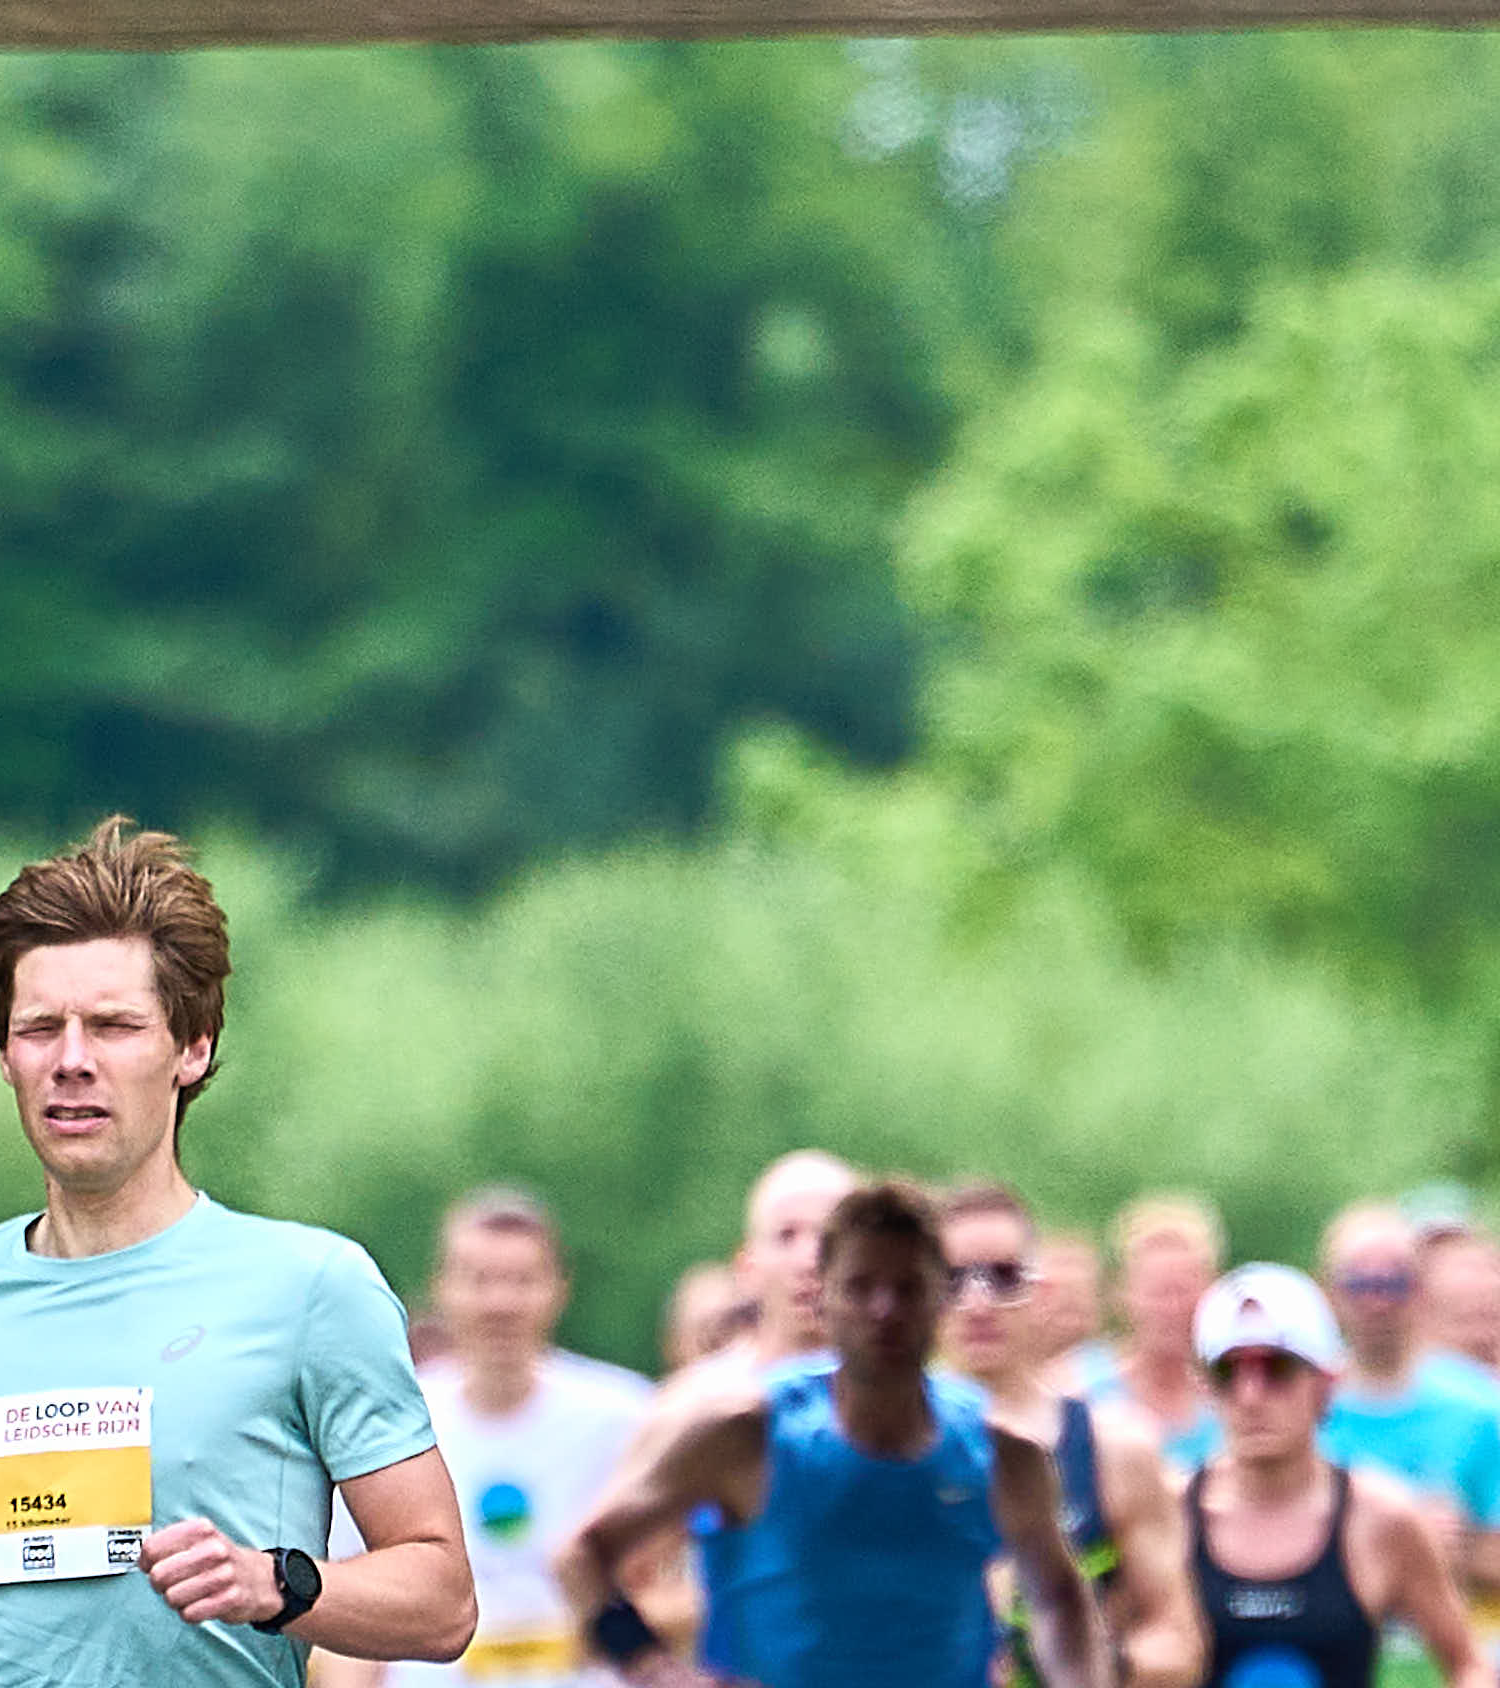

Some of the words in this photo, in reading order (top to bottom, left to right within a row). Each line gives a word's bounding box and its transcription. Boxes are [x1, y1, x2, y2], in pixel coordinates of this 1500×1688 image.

[6, 1407, 31, 1424] DE
[36, 1402, 90, 1420] LOOP
[96, 1400, 140, 1415] VAN
[4, 1422, 91, 1442] LEIDSCHE
[97, 1418, 140, 1435] RIJN
[10, 1493, 67, 1513] 15434
[21, 1517, 71, 1528] kilometer
